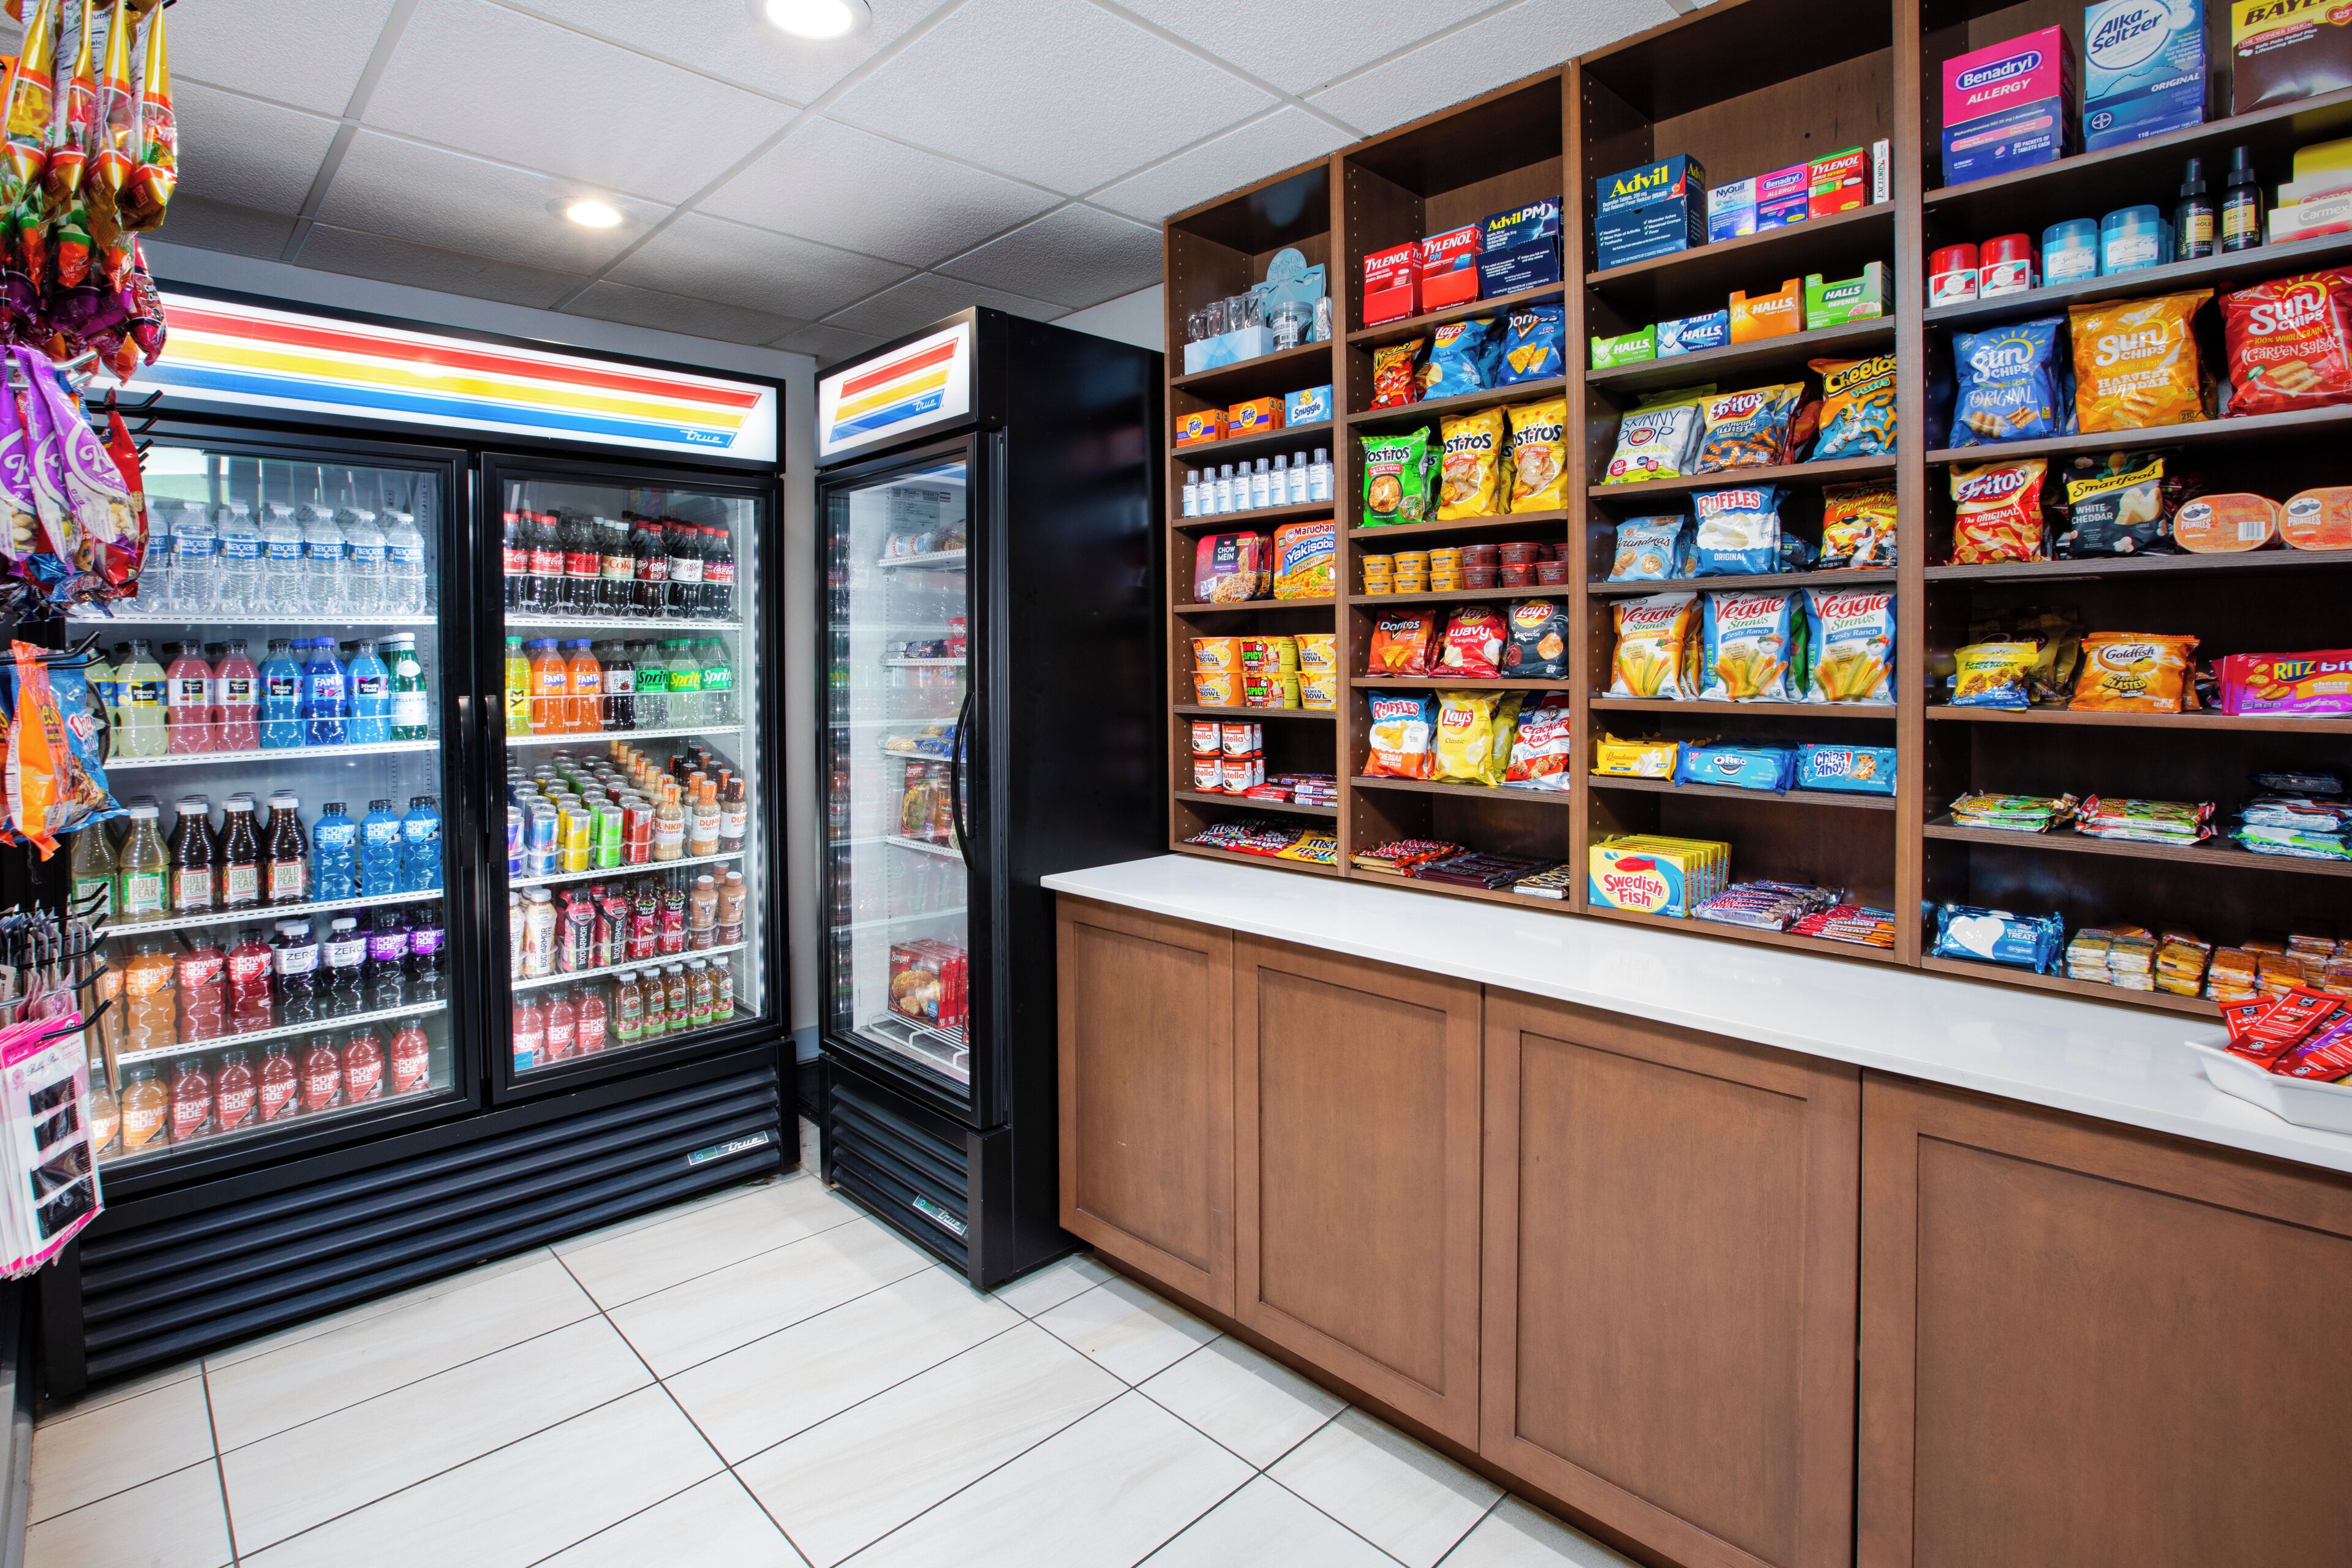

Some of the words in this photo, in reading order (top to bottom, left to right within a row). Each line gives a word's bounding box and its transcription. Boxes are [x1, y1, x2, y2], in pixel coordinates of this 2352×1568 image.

[2091, 13, 2163, 54] Seltzer
[2285, 32, 2303, 41] Relief
[1964, 55, 2033, 87] Benadryl
[2151, 73, 2200, 92] ORIGINAL
[1966, 78, 2032, 106] ALLERGY
[1811, 156, 1860, 177] TYLENOL
[1826, 168, 1847, 177] SEVERE
[1610, 165, 1668, 198] Advil
[1766, 173, 1800, 189] Benadryl
[1716, 183, 1744, 197] NyQuil
[1766, 185, 1796, 198] ALLERGY
[1487, 211, 1521, 232] Advil
[1521, 203, 1547, 222] PM
[2300, 202, 2350, 222] Carmex
[1365, 251, 1410, 274] TYLENOL
[1428, 252, 1442, 263] PM
[1376, 271, 1393, 281] Strength
[1825, 286, 1861, 300] HALLS
[1828, 297, 1860, 308] DEFENSE
[1436, 323, 1467, 341] Lay's
[2255, 335, 2273, 344] 100%
[2301, 325, 2323, 337] GRAIN
[2120, 344, 2166, 361] CHIPS
[1991, 363, 2029, 379] CHIPS
[2118, 363, 2140, 372] WHOLE
[2141, 359, 2163, 369] GRAIN
[2097, 368, 2171, 388] HARVEST
[913, 398, 937, 412] true
[1294, 402, 1321, 420] Snuggle
[1711, 391, 1765, 421] Fritos
[1241, 409, 1256, 423] Tide
[1623, 410, 1680, 427] SKINNY
[1188, 420, 1202, 434] Tide
[680, 429, 723, 444] true
[1365, 445, 1410, 463] TOSTITOS
[1956, 468, 2026, 502] Fritos
[2073, 465, 2157, 497] Smartfood
[1698, 490, 1761, 518] RUFFLES
[2075, 503, 2106, 514] WHITE
[1976, 508, 2020, 523] ORIGINAL
[2071, 513, 2114, 525] CHEDDAR
[2288, 514, 2321, 527] PRINGLES
[1294, 524, 1335, 536] Maruchan
[2180, 519, 2212, 531] PRINGLES
[177, 537, 213, 551] niagara
[268, 541, 303, 554] niagara
[1218, 553, 1234, 562] MEIN
[1286, 538, 1334, 565] Yakisoba
[1714, 552, 1746, 561] ORIGINAL
[684, 564, 700, 573] Pepper
[1295, 560, 1315, 573] Chicken
[1316, 555, 1329, 564] Flavor
[1841, 592, 1872, 601] garden
[1515, 605, 1553, 619] Lay's
[1814, 594, 1890, 621] Veggie
[1621, 606, 1684, 625] Veggie
[1380, 620, 1421, 631] Doritos
[1630, 621, 1666, 632] Straws
[1831, 614, 1875, 631] Straws
[1450, 625, 1490, 640] wavy
[1625, 631, 1646, 640] Cheddar
[1725, 630, 1745, 640] Zesty
[1831, 632, 1851, 641] Zesty
[1853, 628, 1877, 636] Ranch
[1243, 641, 1257, 650] HOT
[1244, 651, 1263, 660] SPICY
[2106, 646, 2156, 659] Goldfish
[1964, 662, 1988, 671] SNACK
[314, 676, 344, 688] FANTA
[1246, 677, 1262, 687] HOT
[2104, 678, 2147, 690] BLASTED
[1247, 687, 1268, 695] SPICY
[1373, 700, 1420, 720] RUFFLES
[1521, 719, 1568, 734] Cracker
[1523, 729, 1554, 744] Jack
[1606, 751, 1638, 761] Bauducco
[1713, 757, 1746, 767] OREO
[1815, 751, 1845, 766] Chips
[323, 824, 355, 834] POWER
[368, 821, 399, 831] POWER
[406, 819, 437, 828] POWER
[324, 832, 344, 841] ADE
[132, 880, 157, 891] GOLD
[183, 874, 206, 885] GOLD
[1604, 874, 1665, 898] Swedish
[132, 886, 157, 898] PEAK
[183, 882, 208, 894] PEAK
[1618, 889, 1653, 908] Fish
[2008, 932, 2037, 942] TREATS
[286, 949, 316, 960] ZERO
[334, 944, 365, 956] ZERO
[892, 951, 911, 964] Banquet
[2281, 1006, 2315, 1017] FRUIT
[2266, 1019, 2301, 1028] STRAWBERRY
